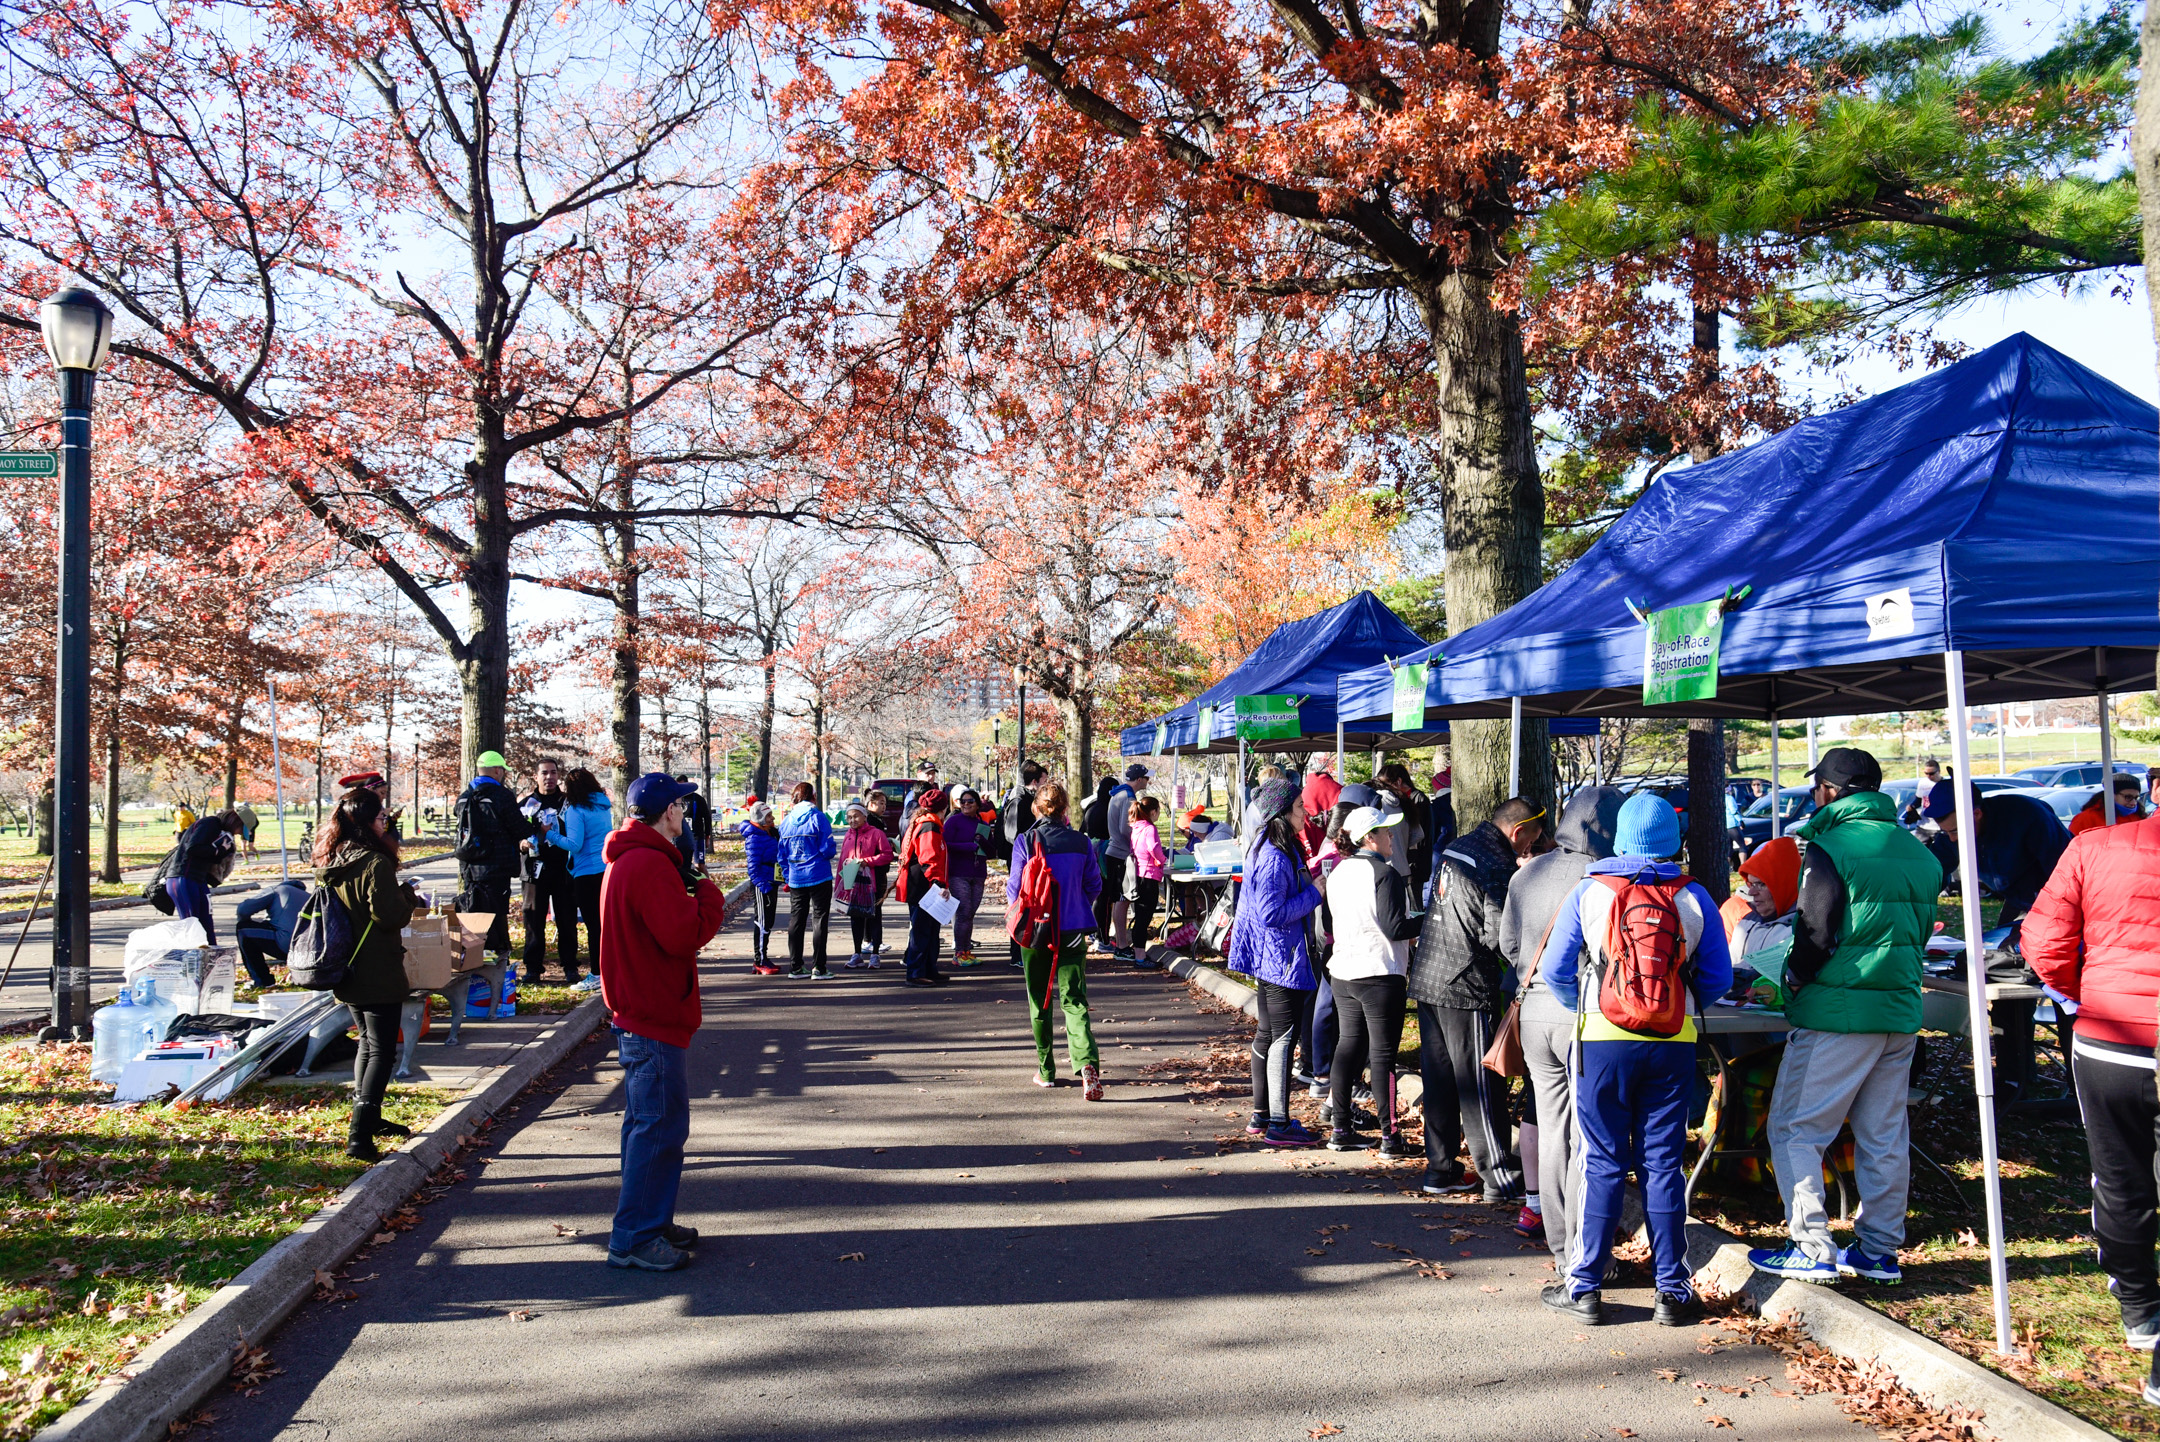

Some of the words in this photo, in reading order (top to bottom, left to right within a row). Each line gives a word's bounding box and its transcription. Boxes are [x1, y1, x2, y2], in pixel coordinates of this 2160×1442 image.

[19, 458, 50, 469] STREET
[1651, 634, 1710, 658] Day-of-Race
[1651, 651, 1709, 675] Registration
[1238, 713, 1298, 723] Pre-Registration
[1762, 1255, 1818, 1269] ADIDAS
